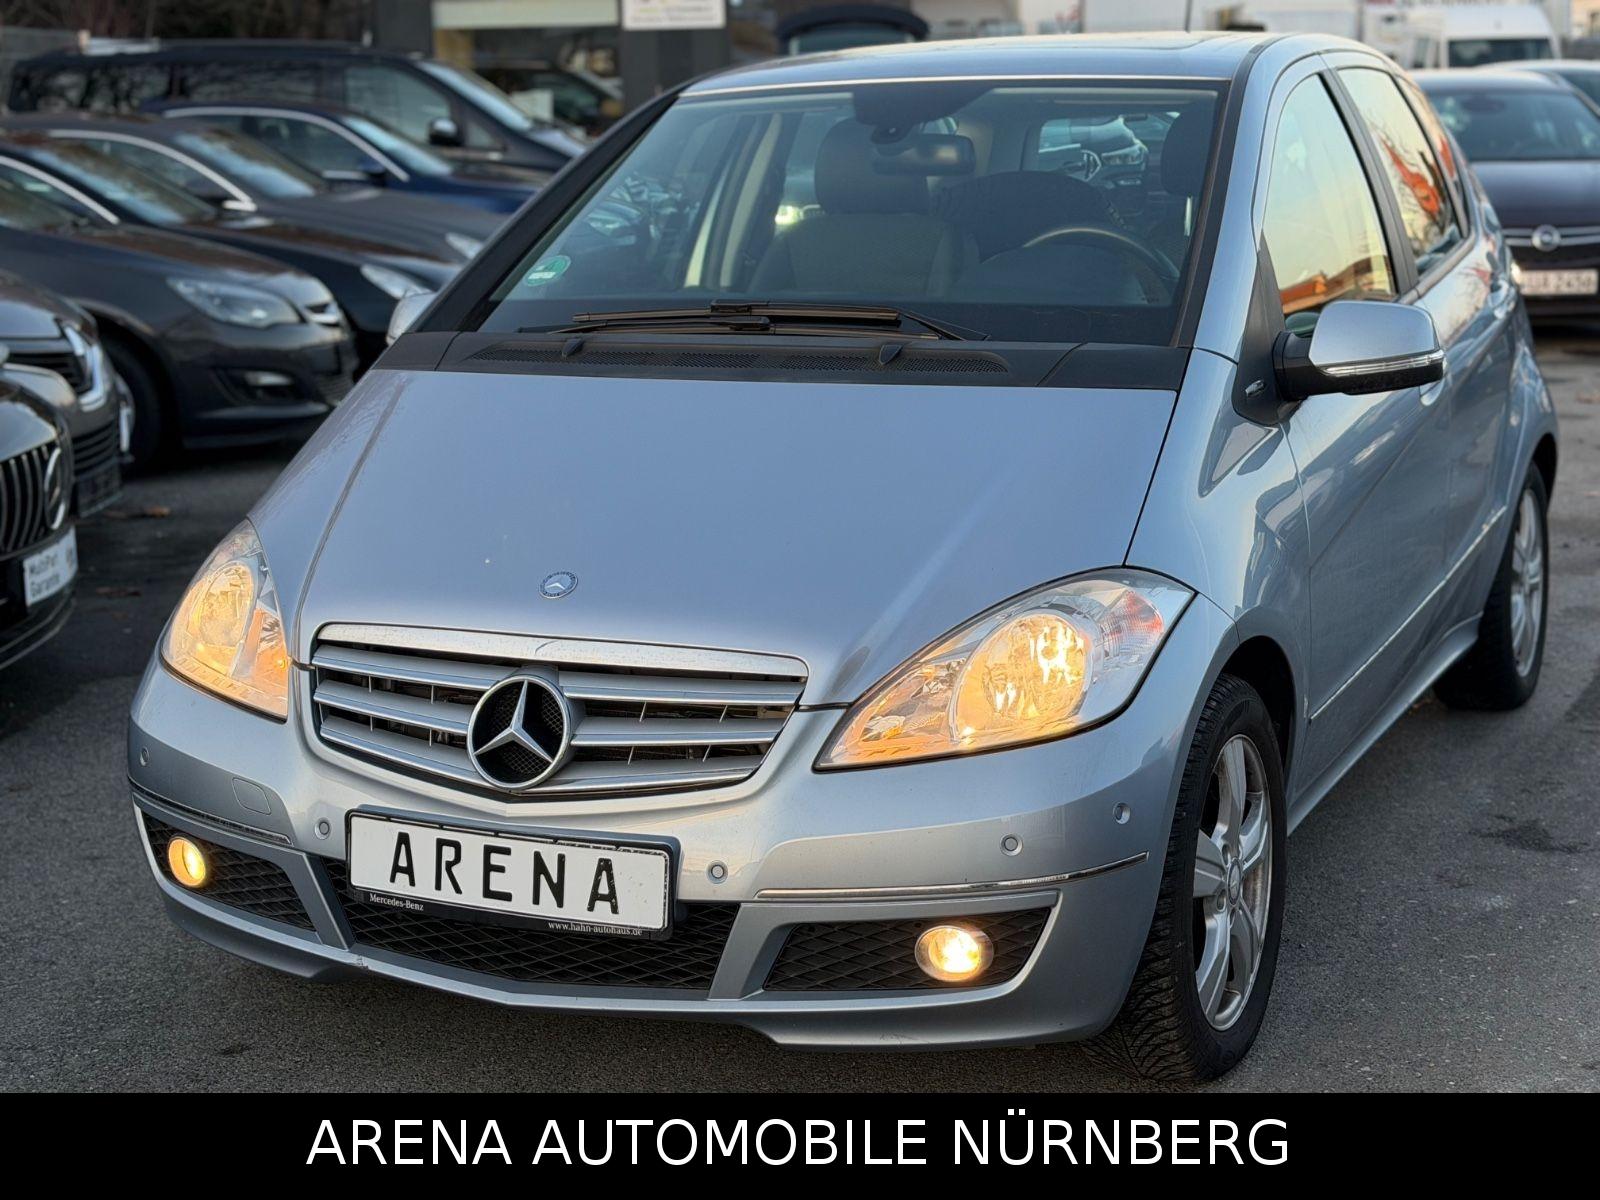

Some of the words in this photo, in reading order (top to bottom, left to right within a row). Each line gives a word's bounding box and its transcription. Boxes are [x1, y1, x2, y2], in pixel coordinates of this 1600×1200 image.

[389, 831, 620, 915] ARENA
[368, 892, 425, 912] Mercedes-Benz
[548, 920, 644, 938] www.hahn-autohaus.de
